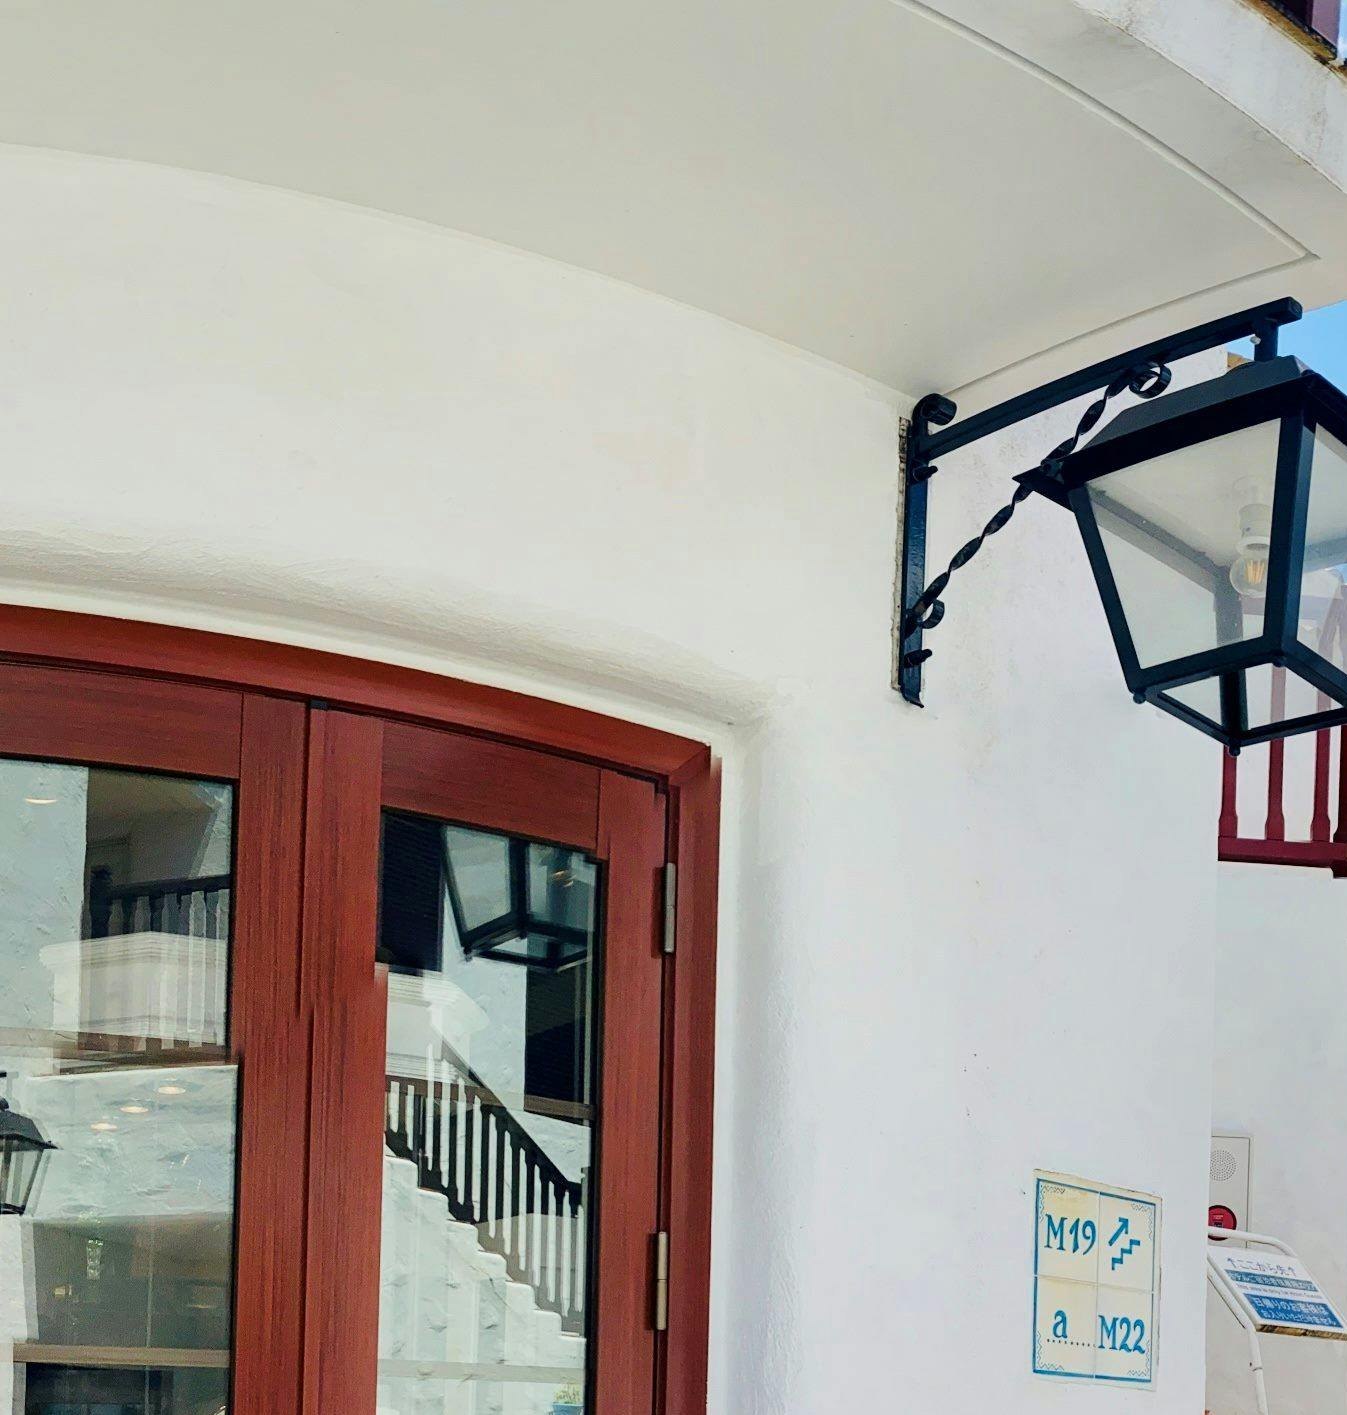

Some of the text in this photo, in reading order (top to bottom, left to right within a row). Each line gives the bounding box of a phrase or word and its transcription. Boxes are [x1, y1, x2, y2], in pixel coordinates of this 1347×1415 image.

[1044, 1213, 1097, 1256] M19
[1052, 1309, 1146, 1354] a M22
